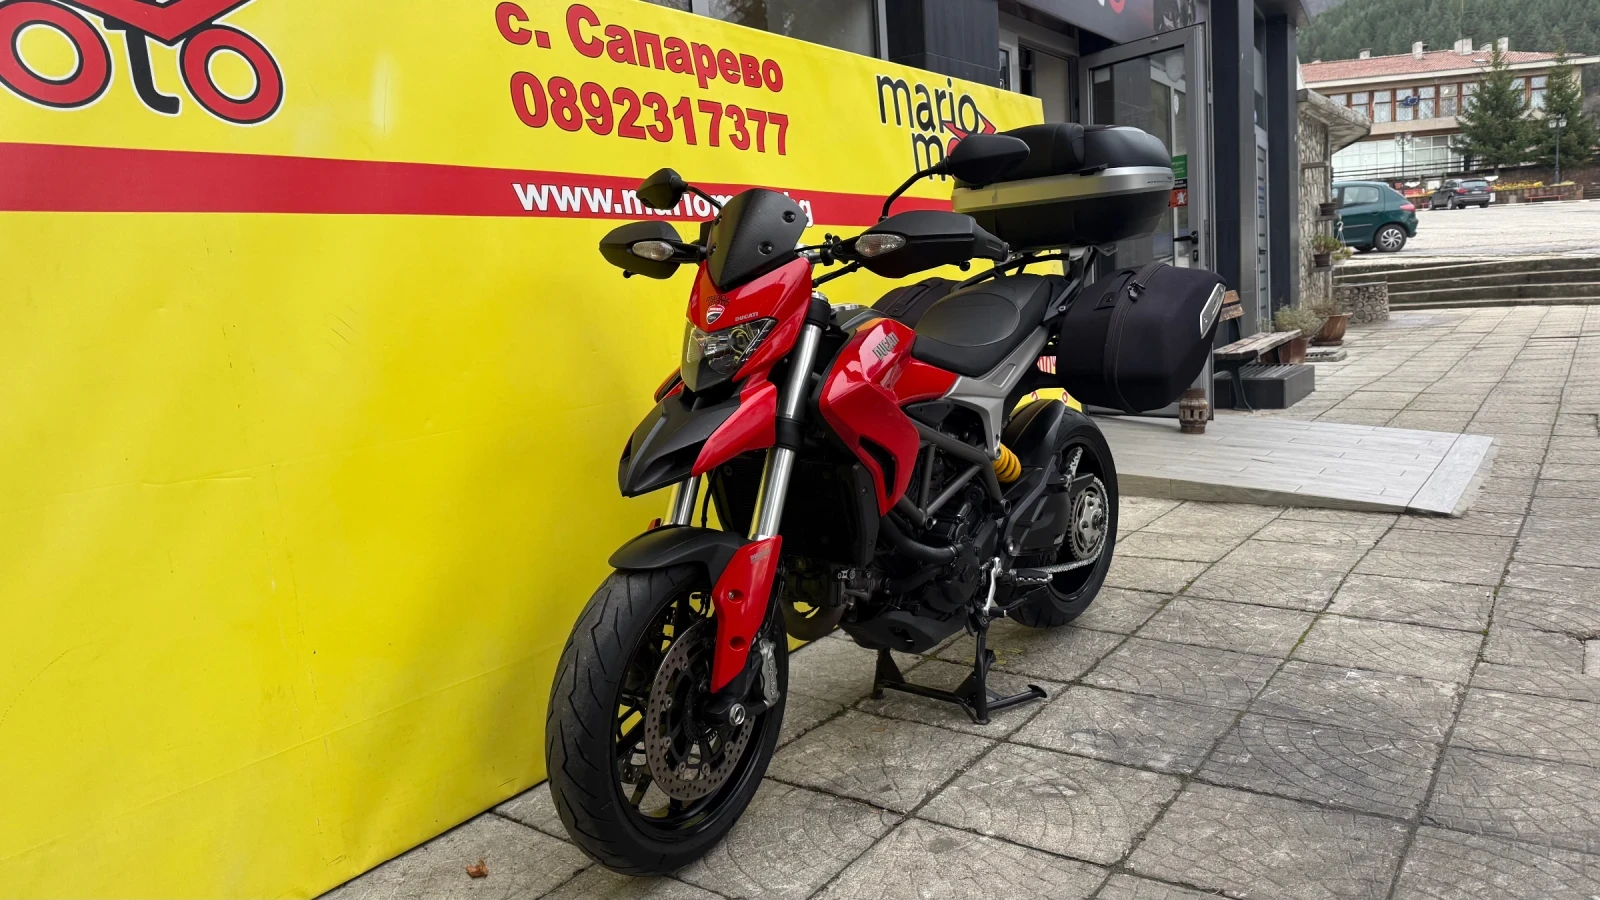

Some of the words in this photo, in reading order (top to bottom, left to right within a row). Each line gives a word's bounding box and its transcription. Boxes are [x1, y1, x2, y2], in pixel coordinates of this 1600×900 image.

[495, 2, 551, 49] с.
[566, 3, 784, 93] Сапарево
[510, 71, 789, 156] 0892317377
[876, 75, 979, 134] mario
[734, 311, 759, 322] DUCATI
